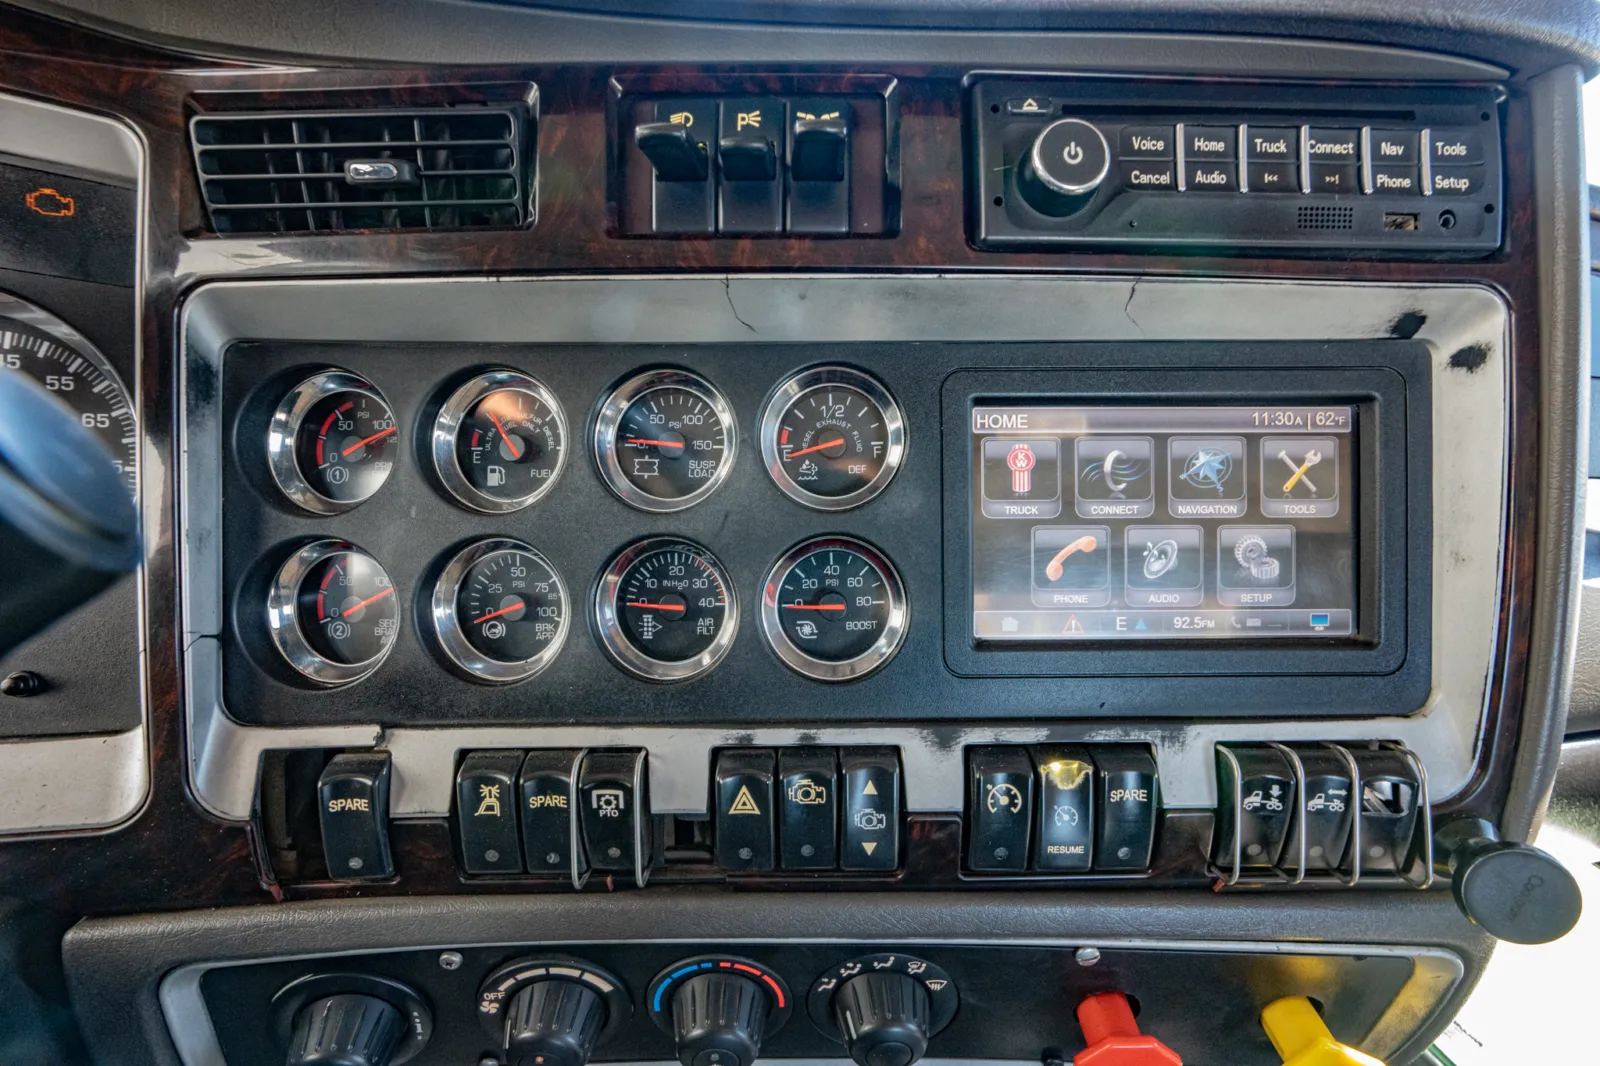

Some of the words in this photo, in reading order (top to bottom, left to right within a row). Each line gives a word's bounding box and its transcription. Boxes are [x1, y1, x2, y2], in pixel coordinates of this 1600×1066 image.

[1132, 136, 1165, 151] Voice
[1194, 137, 1225, 152] Home
[1254, 138, 1288, 153] Truck
[1308, 139, 1354, 154] Connect
[1380, 141, 1404, 156] Nav
[1435, 141, 1467, 156] Tools
[1131, 170, 1170, 185] Cancel
[1195, 170, 1227, 185] Audio
[1376, 174, 1411, 188] Phone
[1434, 175, 1469, 191] Setup
[45, 375, 75, 391] 55
[357, 411, 370, 419] PSI
[820, 404, 845, 419] 1/2
[81, 413, 110, 428] 65
[649, 414, 665, 424] 50
[682, 414, 703, 425] 100
[976, 413, 1029, 429] HOME
[337, 420, 354, 431] 50
[372, 420, 393, 430] 100
[502, 421, 518, 432] UEL
[521, 420, 541, 434] ONLY
[668, 421, 682, 429] PSI
[542, 425, 555, 451] DIESEL
[815, 418, 852, 429] EXHAUST
[851, 430, 863, 453] FLUID
[692, 440, 712, 451] 150
[329, 452, 338, 463] 0
[473, 451, 481, 464] E
[783, 449, 792, 462] E
[873, 445, 882, 459] F
[688, 460, 716, 469] SUSP
[847, 464, 868, 474] DEF
[530, 468, 551, 478] FUEL
[688, 469, 715, 478] LOAD
[1004, 505, 1039, 515] TRUCK
[1091, 505, 1139, 515] CONNECT
[1178, 504, 1238, 515] NAVIGATION
[1283, 504, 1316, 514] TOOLS
[510, 566, 527, 577] 50
[668, 565, 685, 576] 20
[823, 564, 840, 576] 40
[339, 576, 353, 586] 50
[512, 580, 525, 588] PSI
[644, 578, 658, 589] 10
[692, 578, 708, 589] 30
[802, 578, 818, 589] 20
[825, 578, 839, 587] PSI
[847, 576, 864, 588] 60
[488, 583, 503, 594] 25
[534, 582, 549, 593] 75
[698, 597, 715, 608] 40
[856, 596, 872, 607] 80
[1053, 594, 1089, 604] PHONE
[1148, 593, 1180, 604] AUDIO
[1240, 593, 1273, 604] SETUP
[330, 607, 339, 618] 0
[536, 606, 558, 617] 100
[535, 623, 556, 632] BRK
[697, 617, 714, 627] AIR
[845, 620, 878, 631] BOOST
[1115, 616, 1128, 631] E
[374, 627, 395, 636] BRA
[535, 631, 555, 640] APP
[697, 626, 715, 635] FILT
[1109, 789, 1148, 803] SPARE
[328, 798, 369, 813] SPARE
[528, 795, 568, 809] SPARE
[598, 809, 619, 818] PTO
[1047, 845, 1085, 854] RESUME
[483, 991, 506, 1001] OFF
